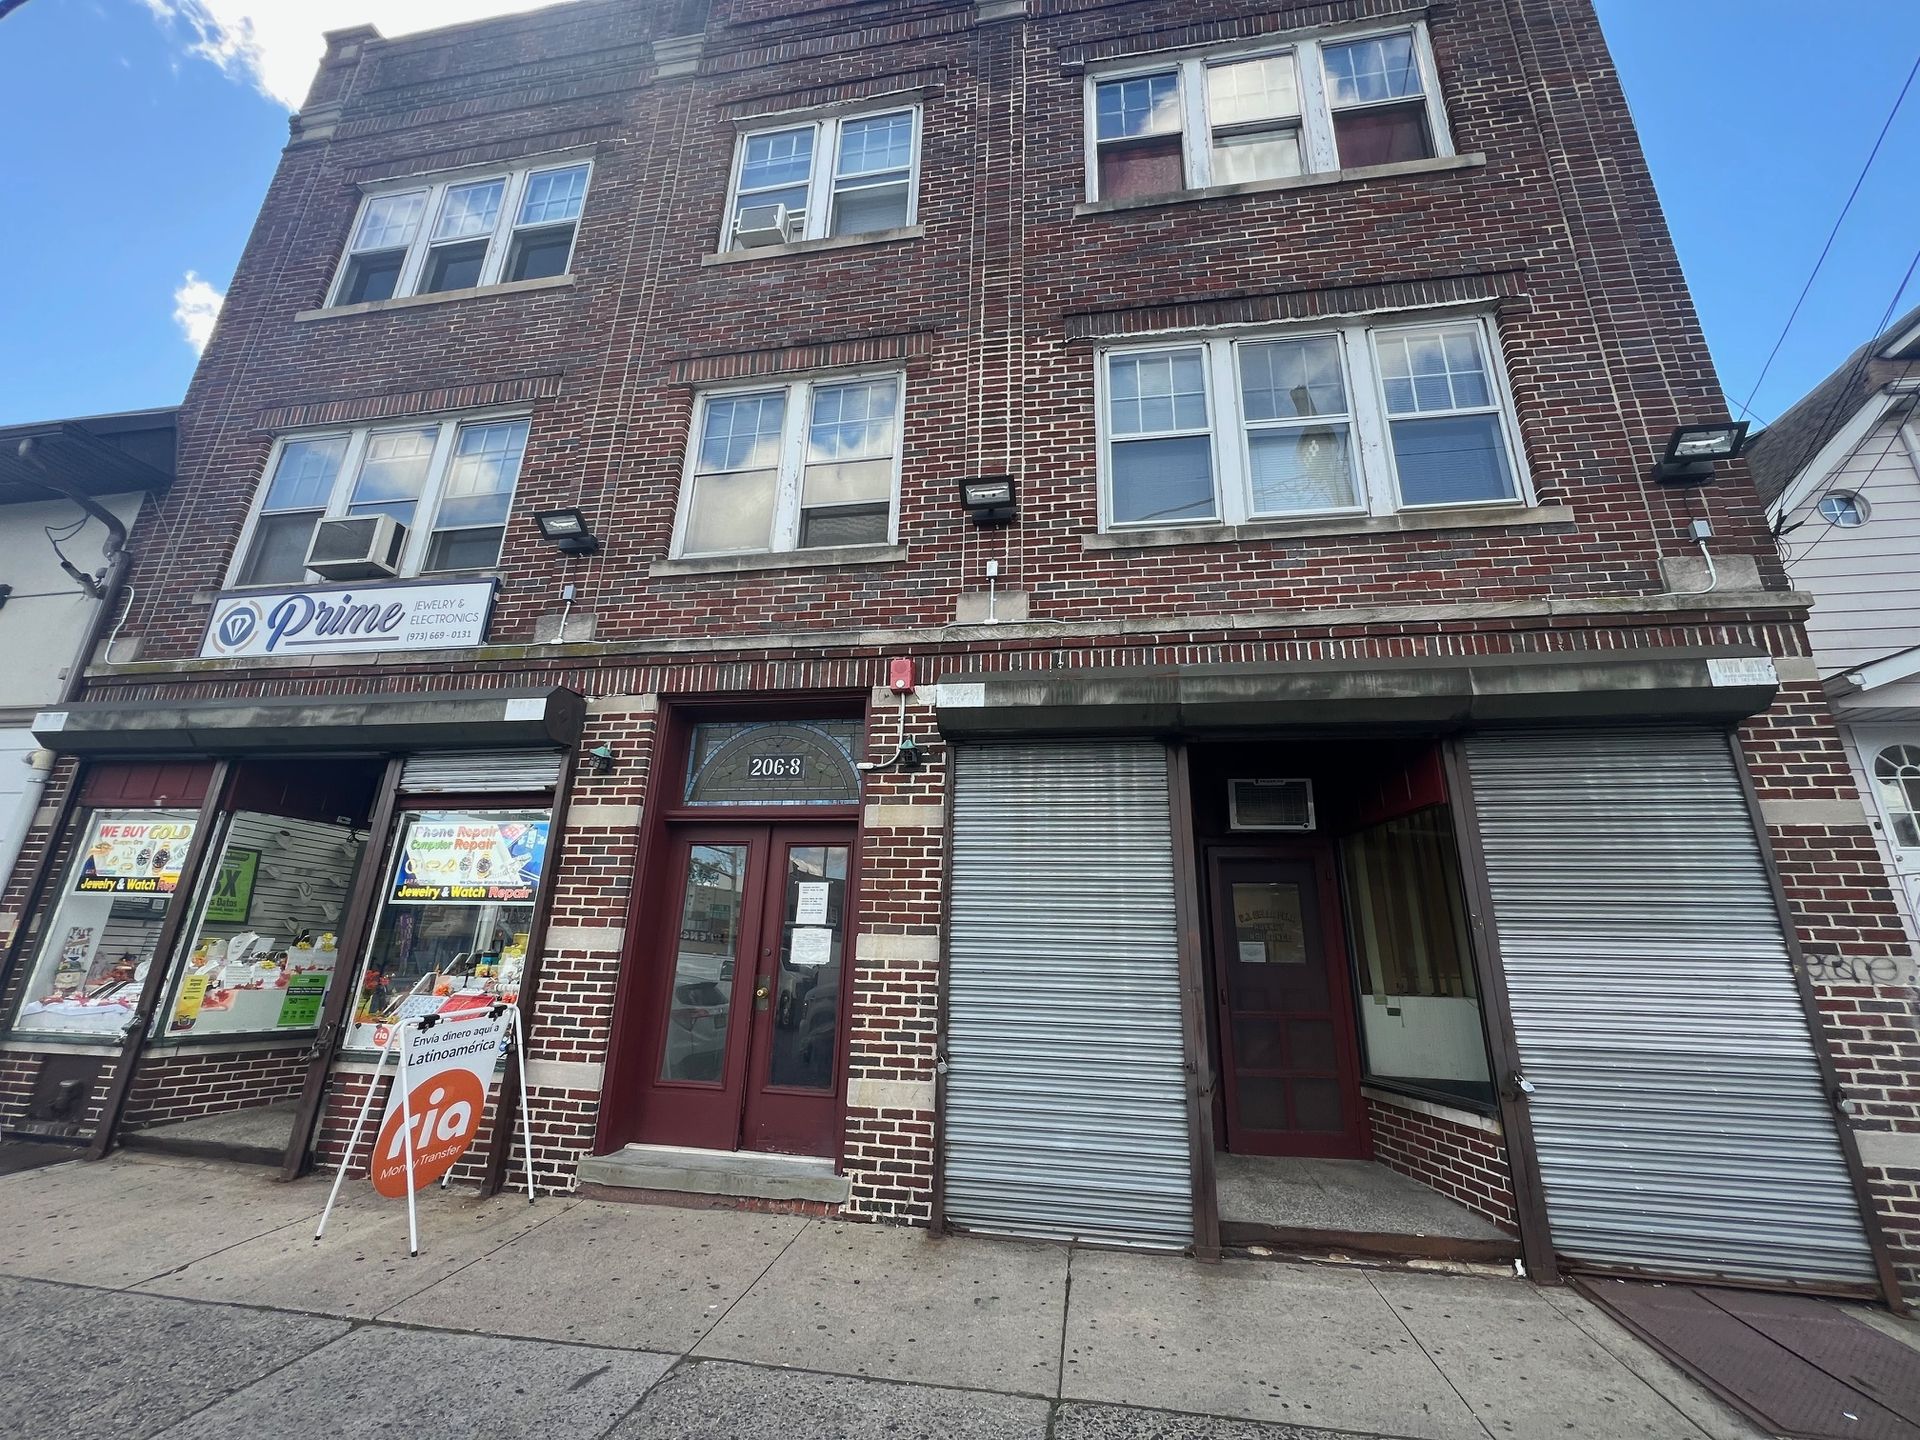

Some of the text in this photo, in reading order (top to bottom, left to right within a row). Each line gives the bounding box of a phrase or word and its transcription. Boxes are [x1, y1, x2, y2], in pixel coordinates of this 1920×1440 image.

[413, 599, 465, 612] JEWELRY &
[267, 594, 405, 652] Prime
[410, 612, 479, 625] ELECTRONICS
[406, 632, 428, 642] (973)
[429, 631, 445, 640] 669
[451, 630, 471, 639] 0131
[751, 758, 801, 776] 206-8
[100, 825, 191, 839] WE BUY GOLD
[415, 826, 497, 839] Phone Repair
[410, 839, 496, 852] Computer Repair
[81, 878, 116, 891] Jewelry
[116, 879, 125, 890] &
[126, 878, 156, 890] Watch
[398, 886, 532, 900] Jewelry & Watch Repair
[375, 1029, 388, 1040] ria
[413, 1036, 439, 1047] Envía
[442, 1030, 471, 1042] dinero
[474, 1025, 493, 1037] aquí
[408, 1040, 495, 1066] Latinoamérica
[387, 1088, 471, 1160] ria
[380, 1144, 461, 1180] Mony Transfer
